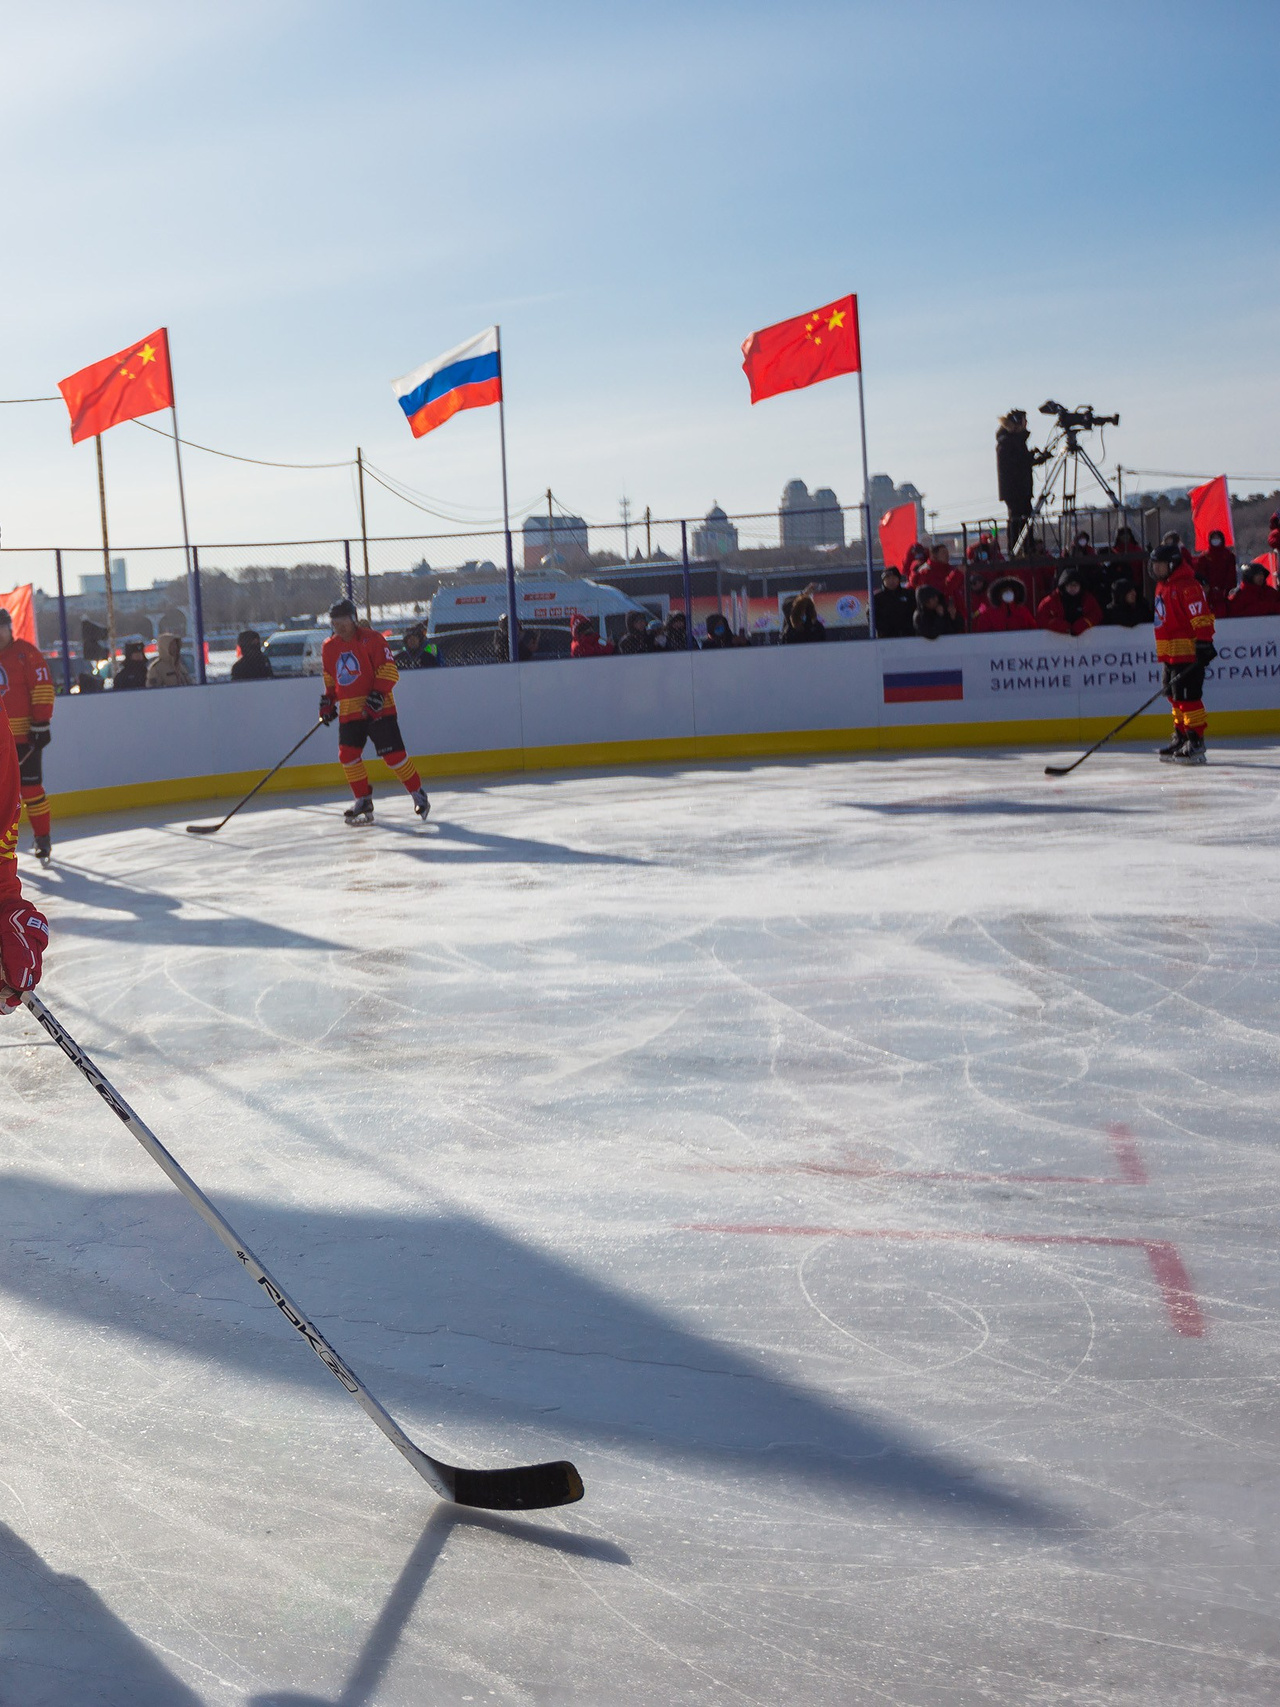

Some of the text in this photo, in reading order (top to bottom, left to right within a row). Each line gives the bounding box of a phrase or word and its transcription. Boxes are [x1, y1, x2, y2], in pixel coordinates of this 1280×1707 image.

[1219, 641, 1278, 660] ССИЙ
[35, 667, 49, 681] 51
[991, 665, 1280, 692] ЗИМНИЕ ИГРЫ Н ОГРАНИ
[236, 1250, 250, 1265] 4K
